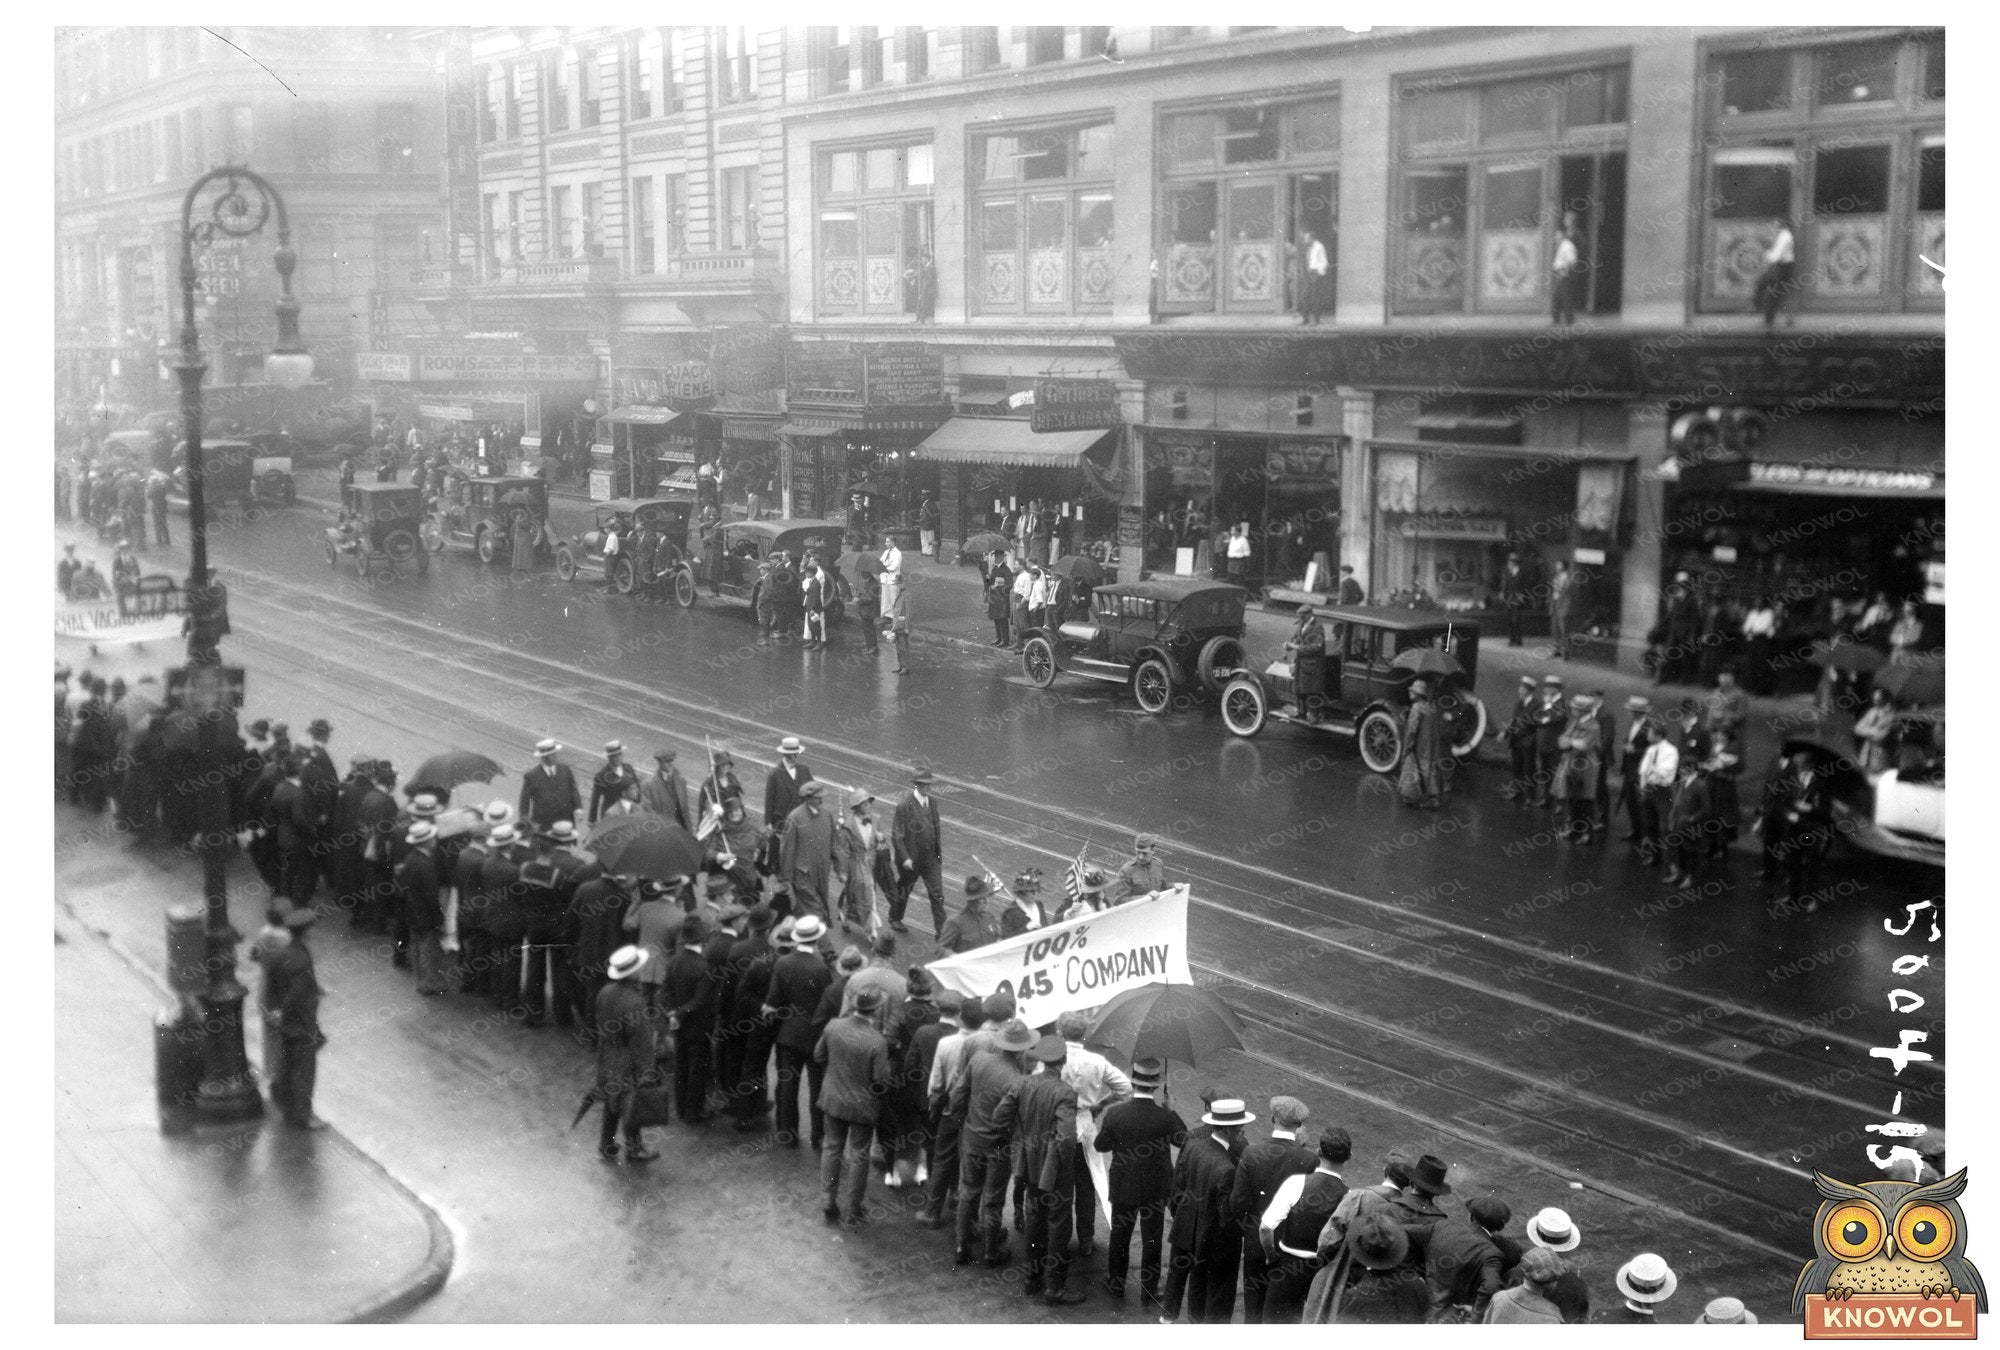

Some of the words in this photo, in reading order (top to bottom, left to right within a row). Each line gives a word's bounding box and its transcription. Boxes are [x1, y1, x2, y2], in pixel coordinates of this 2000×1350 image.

[424, 356, 477, 371] ROOMS
[1023, 925, 1091, 967] 100%
[1066, 944, 1169, 995] COMPANY
